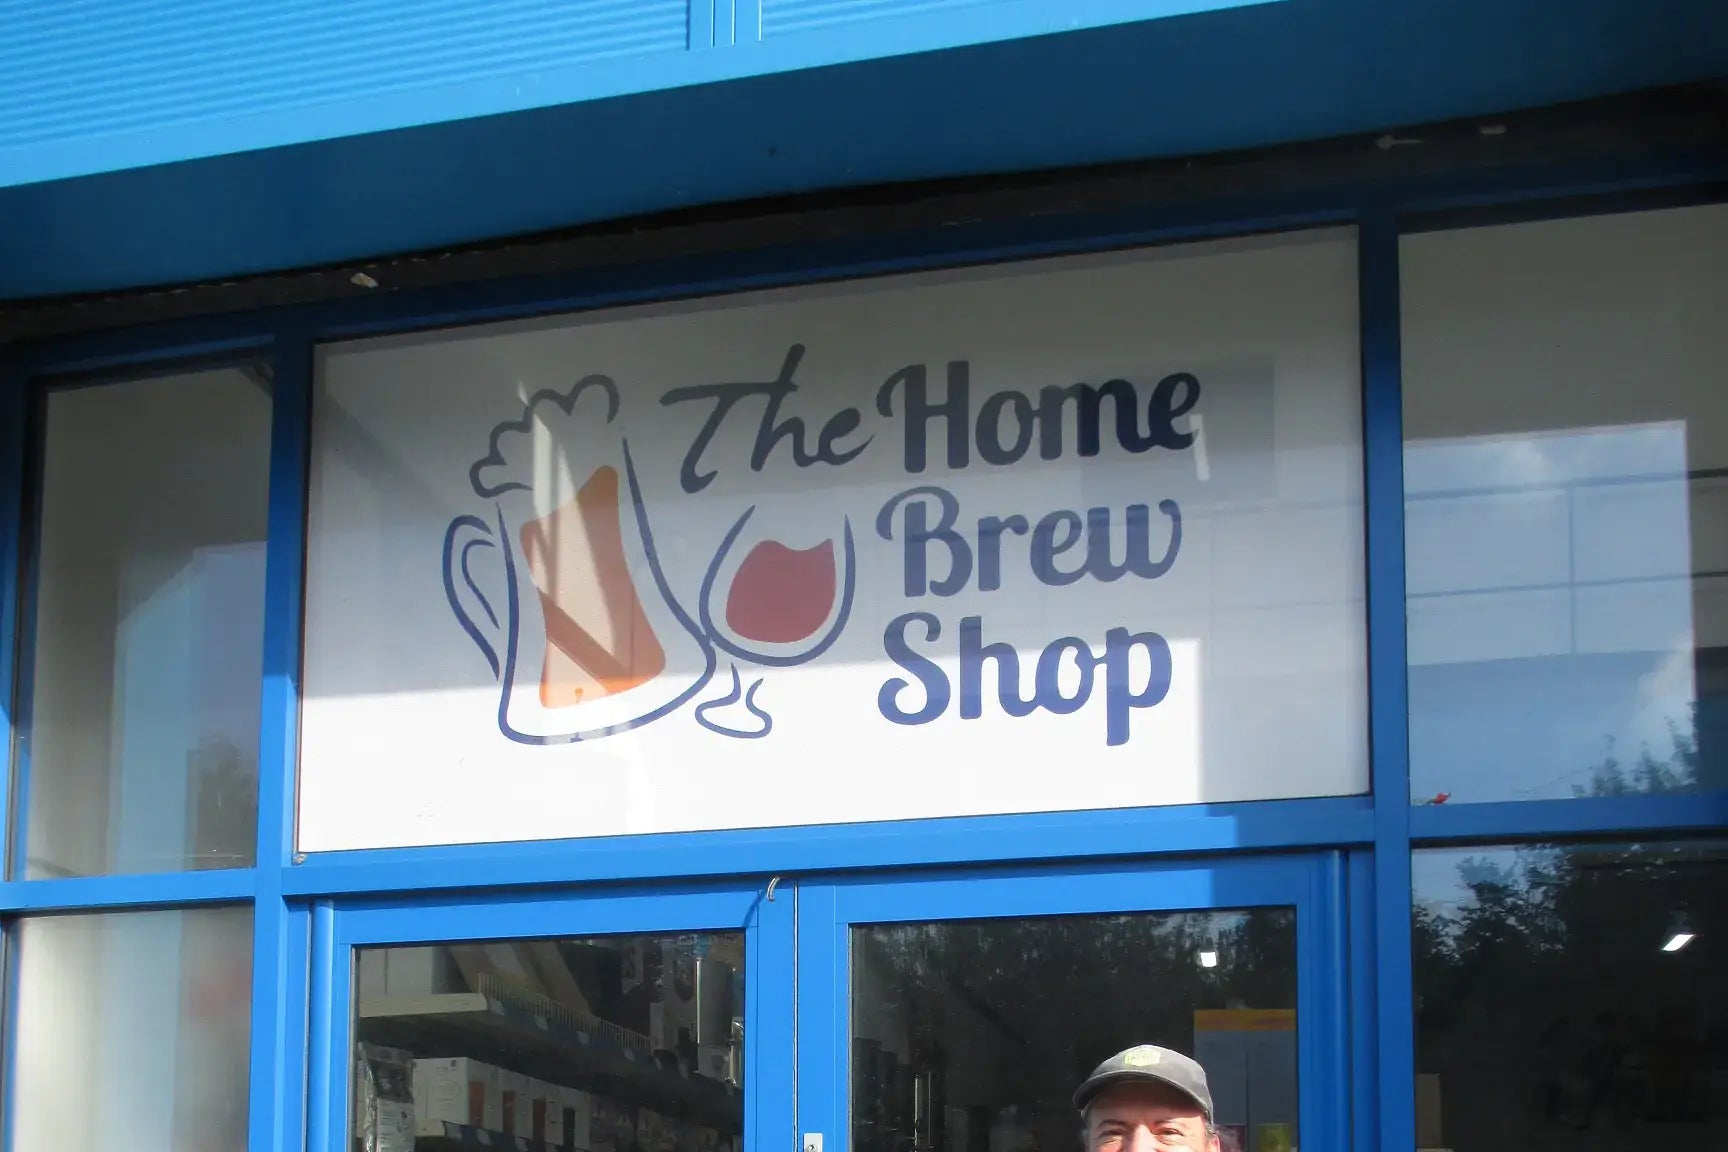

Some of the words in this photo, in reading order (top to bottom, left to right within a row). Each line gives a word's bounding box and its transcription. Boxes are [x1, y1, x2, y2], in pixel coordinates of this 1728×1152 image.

[660, 344, 876, 494] The
[877, 360, 1200, 472] Home
[875, 486, 1182, 597] Brew
[878, 611, 1172, 747] Shop
